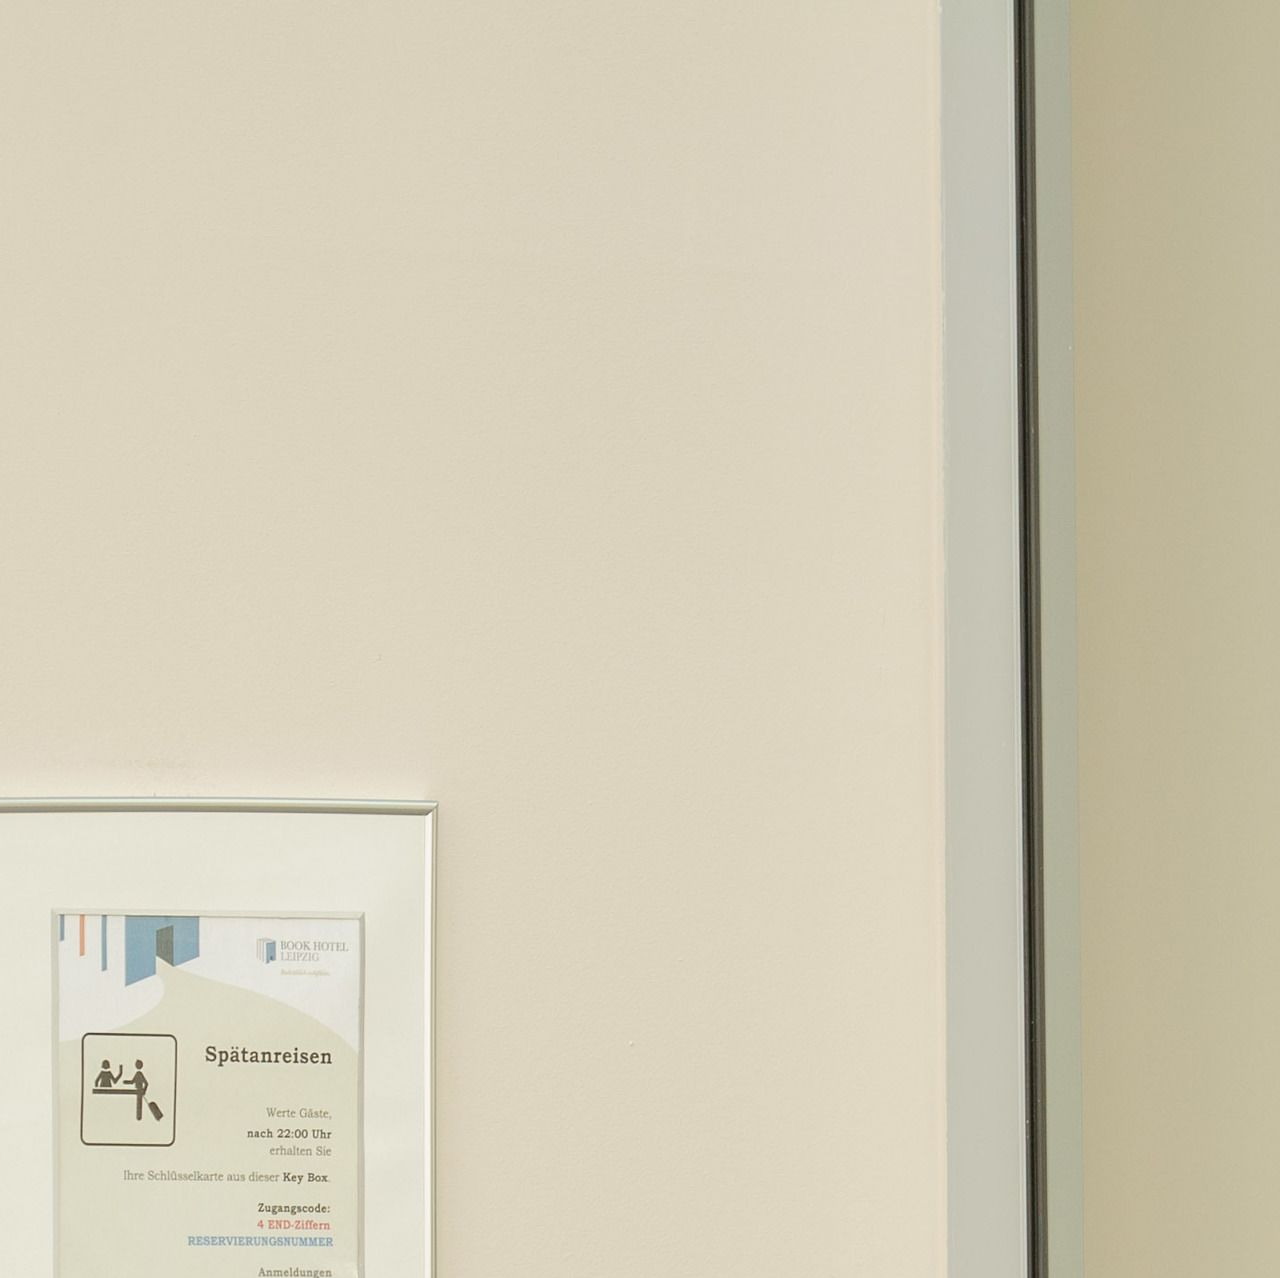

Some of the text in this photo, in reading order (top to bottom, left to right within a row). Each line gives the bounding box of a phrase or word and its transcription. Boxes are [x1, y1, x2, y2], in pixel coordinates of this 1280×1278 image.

[280, 940, 349, 952] BOOK HOTEL
[280, 951, 320, 962] LEIPZIG
[205, 1045, 333, 1067] Spätanreisen
[266, 1106, 333, 1121] Werte Gäste,
[247, 1128, 333, 1140] nach 22:00 Uhr
[268, 1144, 332, 1157] erhalten Sie
[123, 1169, 145, 1181] Ihre
[147, 1169, 224, 1182] Schlüsselkarte
[226, 1173, 246, 1182] aus
[248, 1171, 281, 1183] dieser
[282, 1172, 304, 1185] Key
[257, 1202, 331, 1216] Zugangscode:
[256, 1219, 331, 1231] 4 END-Ziffern
[187, 1234, 335, 1247] RESERVIERUNGSNUMMER
